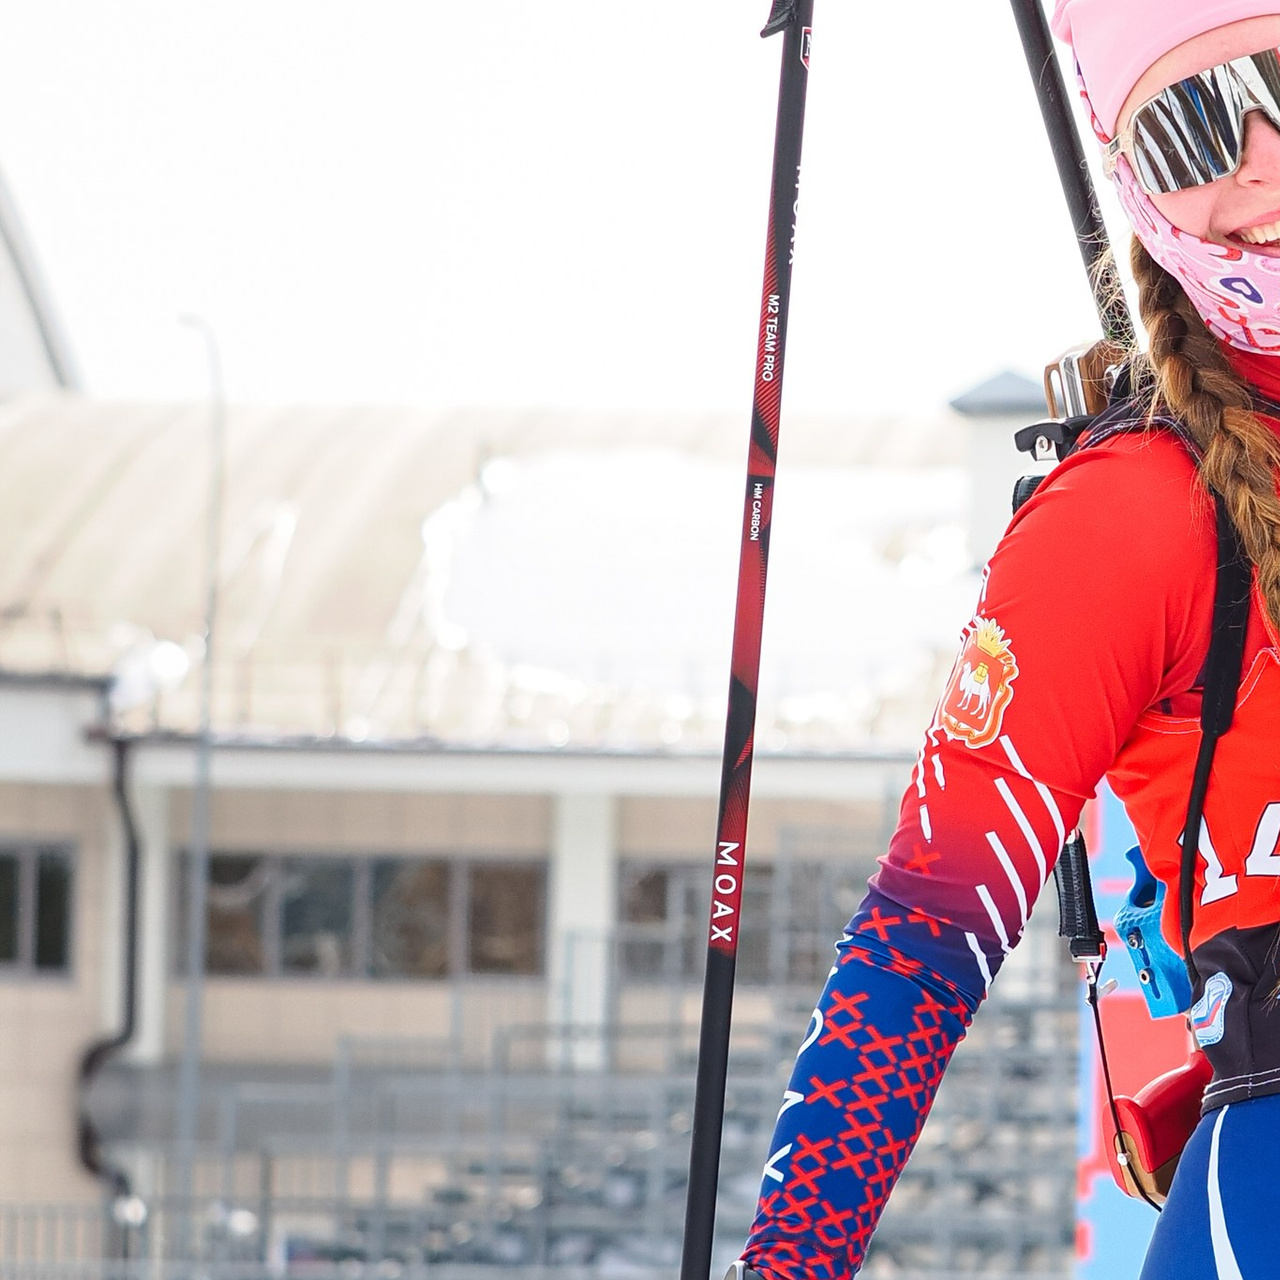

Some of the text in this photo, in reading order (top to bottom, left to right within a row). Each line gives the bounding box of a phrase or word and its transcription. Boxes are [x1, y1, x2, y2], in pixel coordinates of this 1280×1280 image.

[762, 294, 780, 381] M2 TEAM PRO
[750, 483, 763, 541] HM CARBON
[710, 841, 740, 942] MOAX
